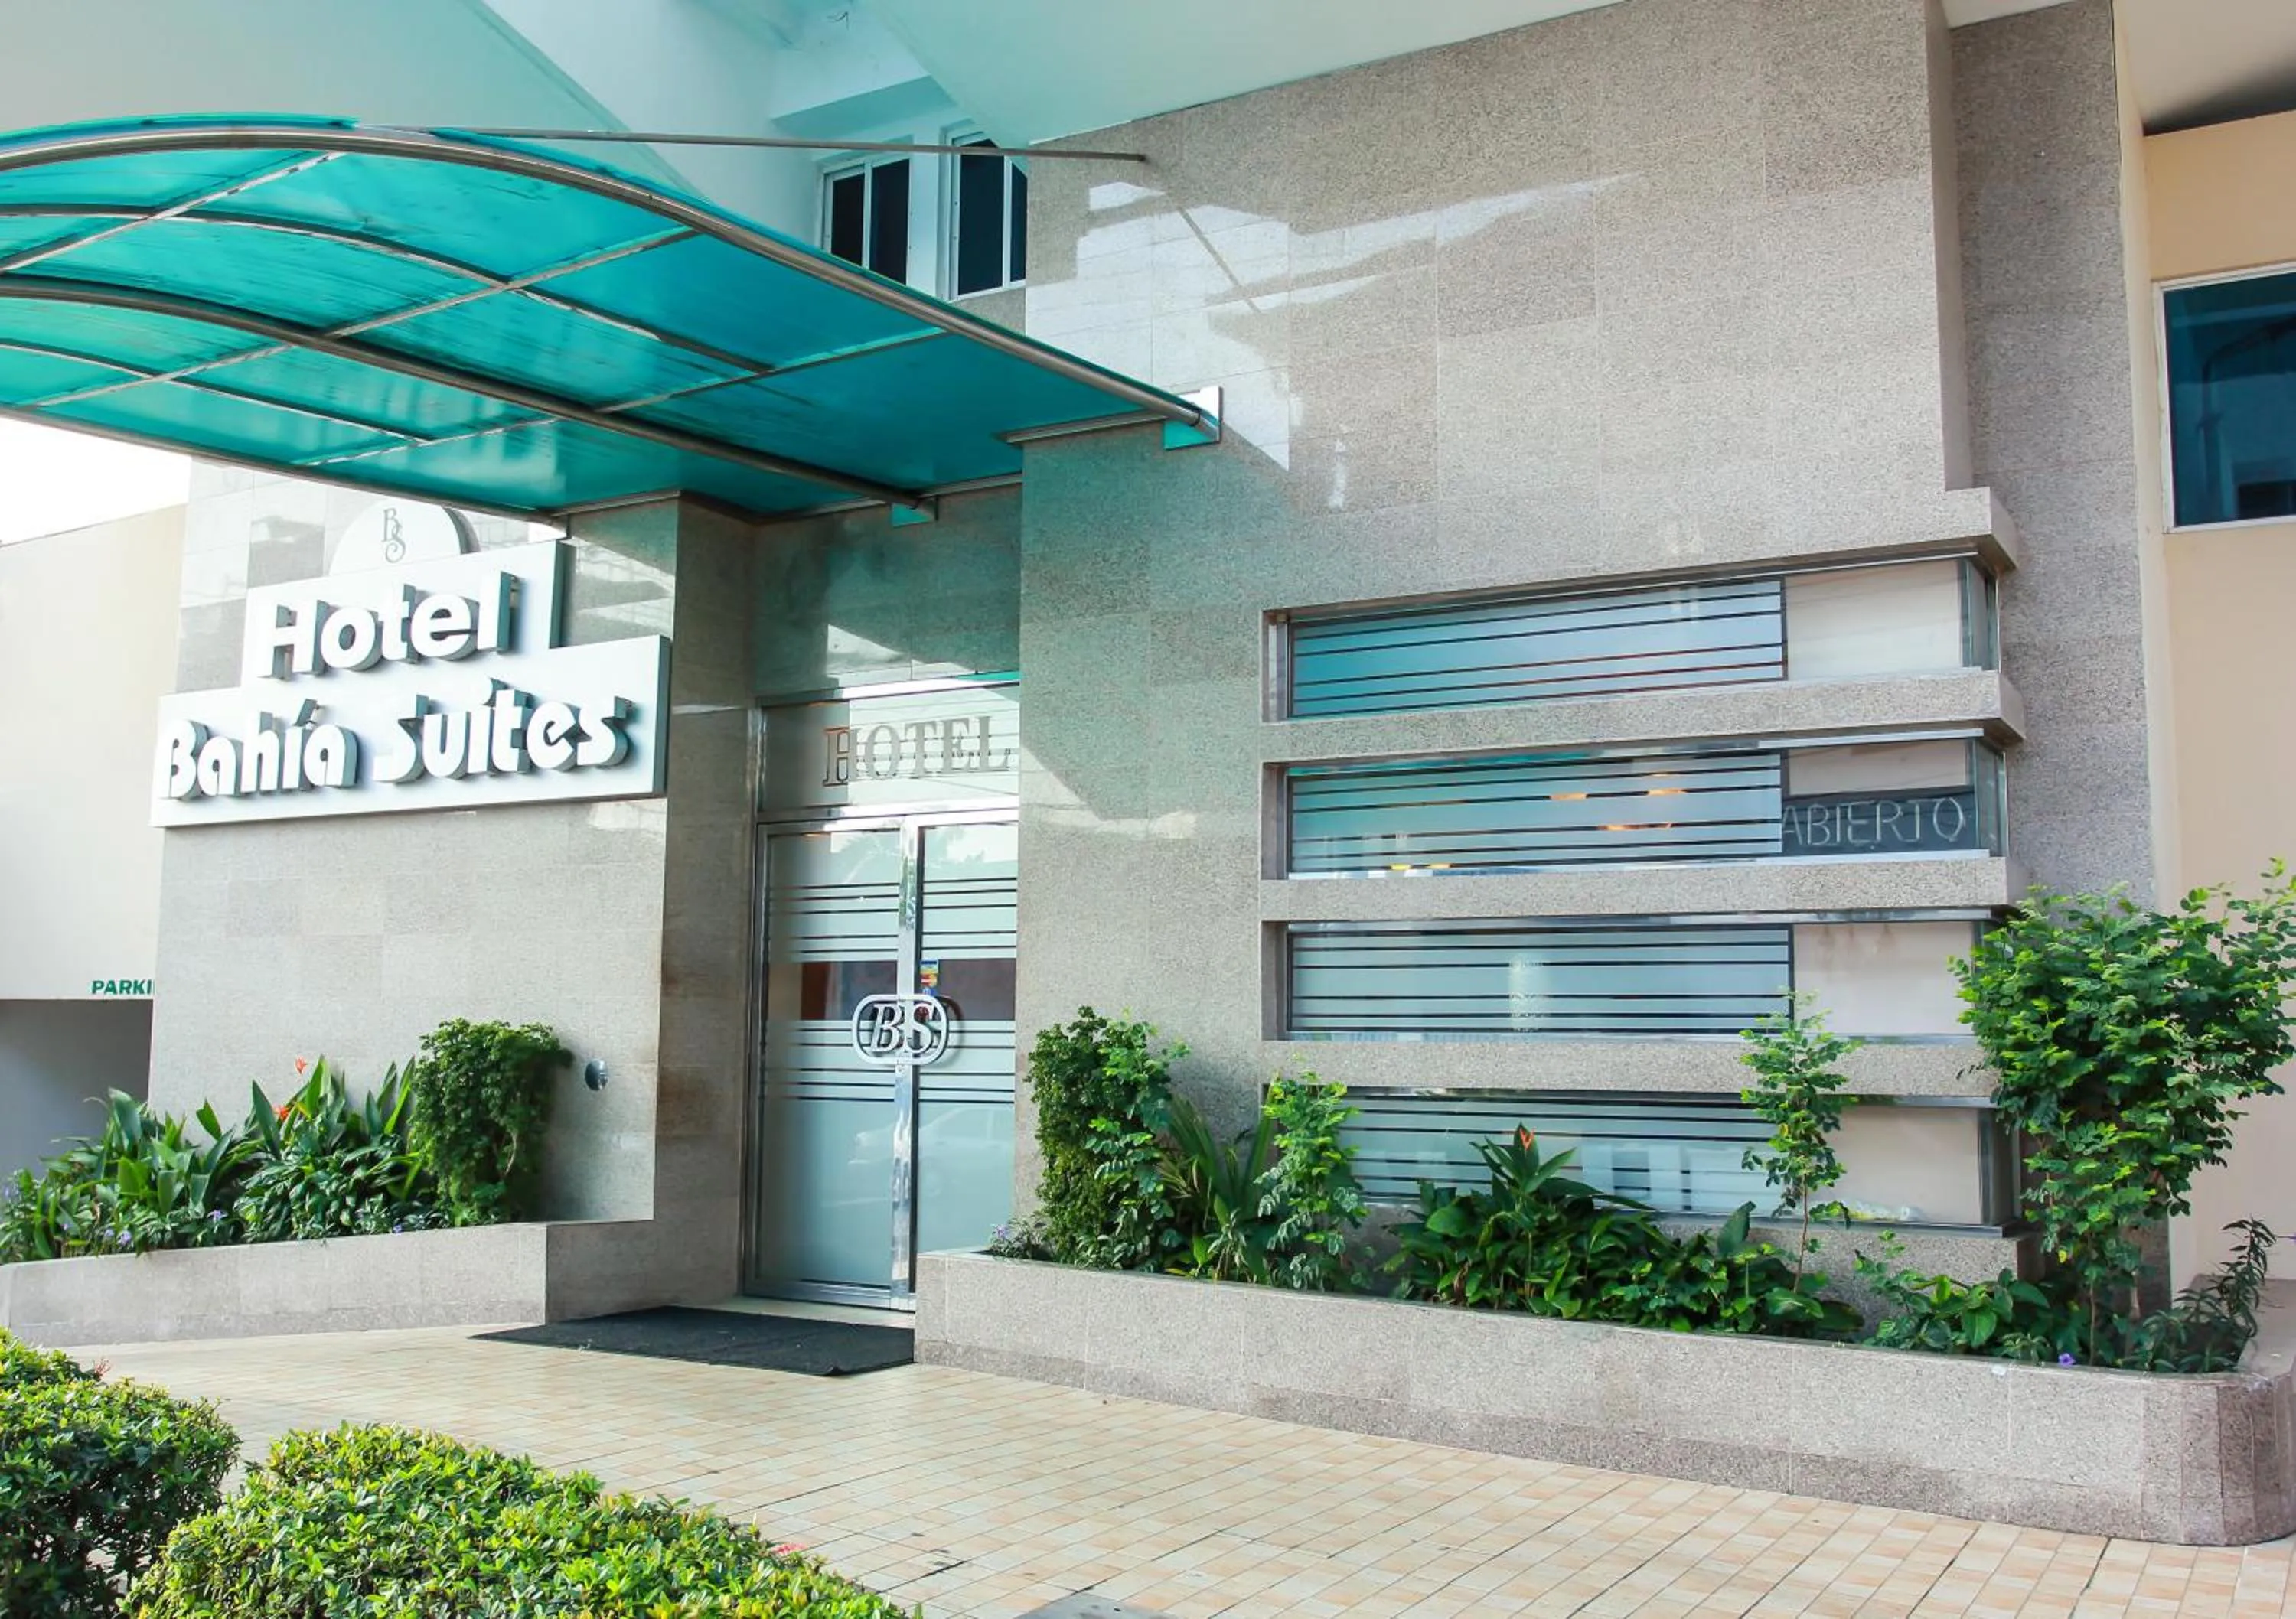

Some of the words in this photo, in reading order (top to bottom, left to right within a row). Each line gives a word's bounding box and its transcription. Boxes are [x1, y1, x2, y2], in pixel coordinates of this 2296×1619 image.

[256, 571, 517, 681] Hotel
[156, 698, 358, 800] Bahía
[373, 677, 630, 784] Suites
[823, 715, 1010, 787] HOTEL
[1780, 796, 1964, 845] ABIERTO
[91, 979, 155, 995] PARKI
[863, 1002, 934, 1054] BS
